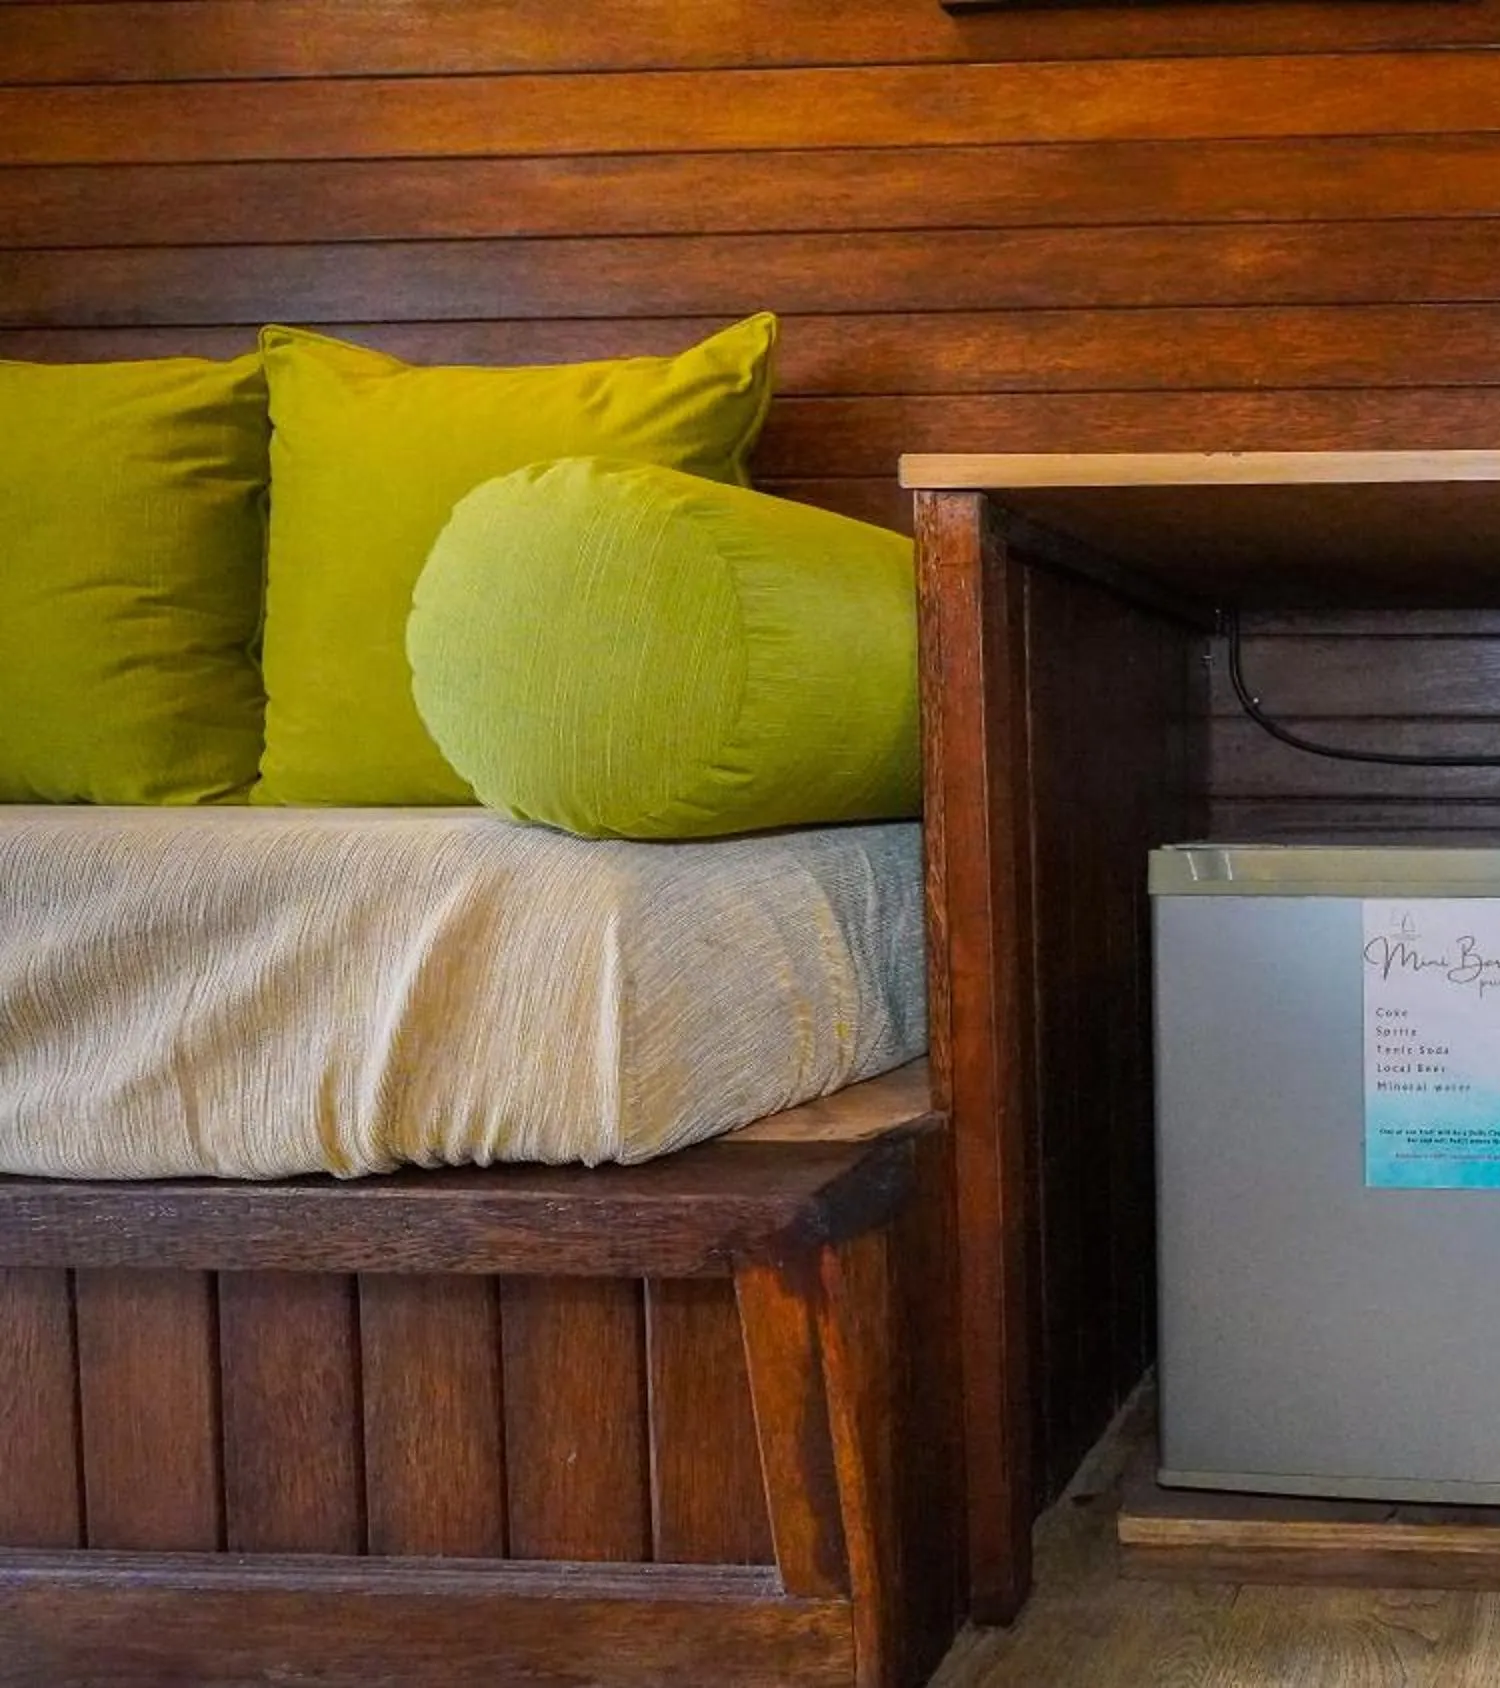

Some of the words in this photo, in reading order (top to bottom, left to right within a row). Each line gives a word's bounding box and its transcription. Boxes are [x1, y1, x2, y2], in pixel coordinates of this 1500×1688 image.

[1363, 936, 1448, 981] Mini
[1375, 1008, 1408, 1018] Coke
[1419, 1045, 1450, 1055] Soda
[1377, 1064, 1411, 1073] Local
[1377, 1081, 1427, 1092] Mineral
